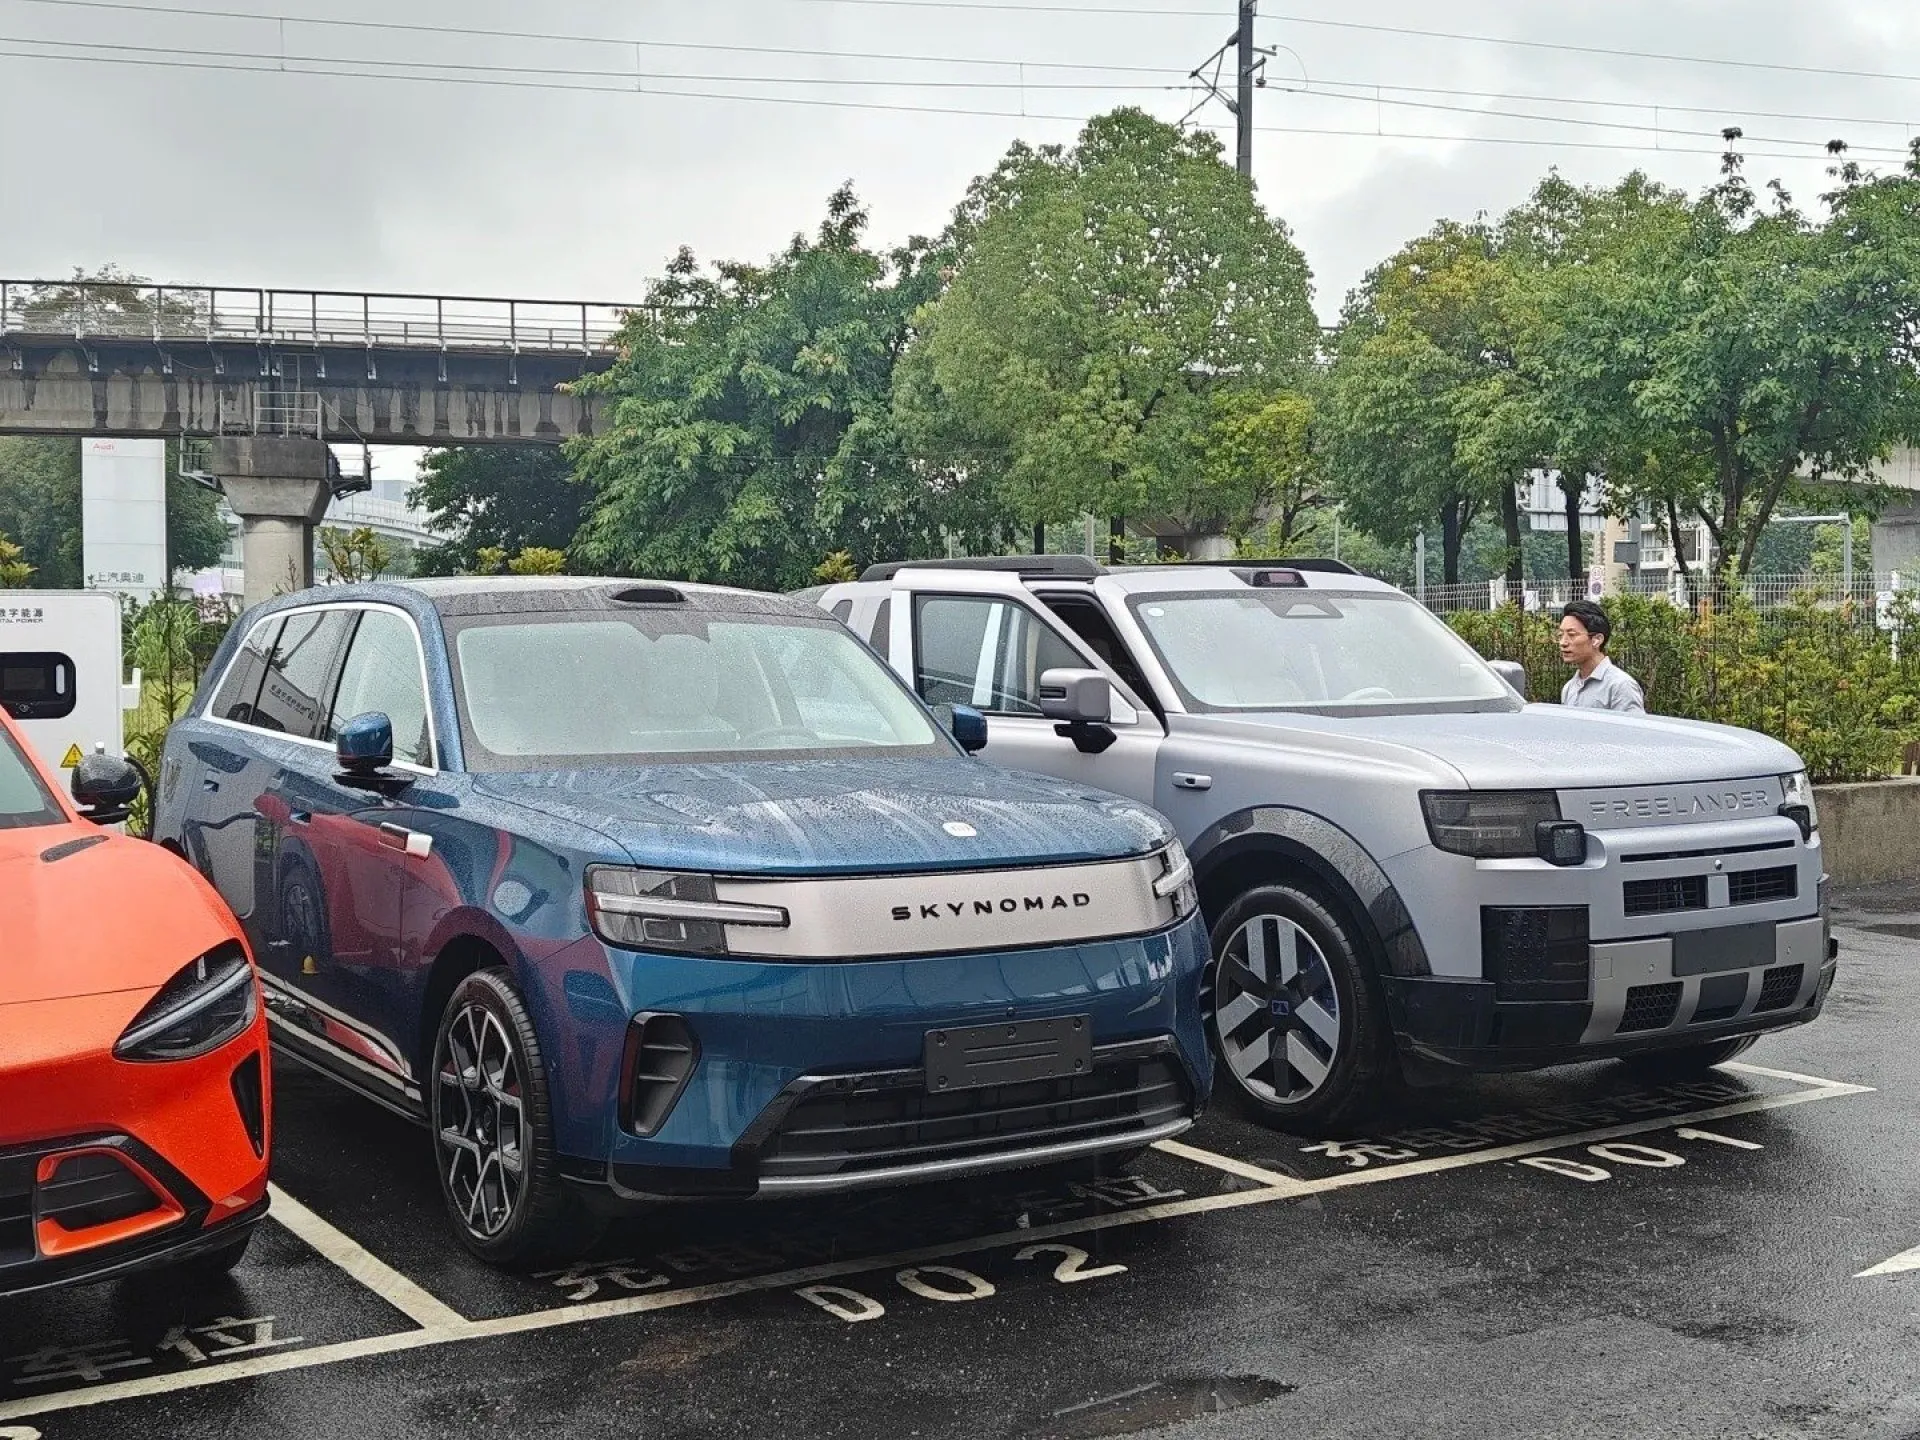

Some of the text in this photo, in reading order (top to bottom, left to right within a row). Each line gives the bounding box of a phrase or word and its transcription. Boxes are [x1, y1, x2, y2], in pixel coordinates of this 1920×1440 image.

[93, 443, 115, 451] Audi
[95, 572, 144, 584] 上汽奥迪
[1589, 790, 1769, 820] FREELANDER
[891, 893, 1090, 921] SKYNOMAD
